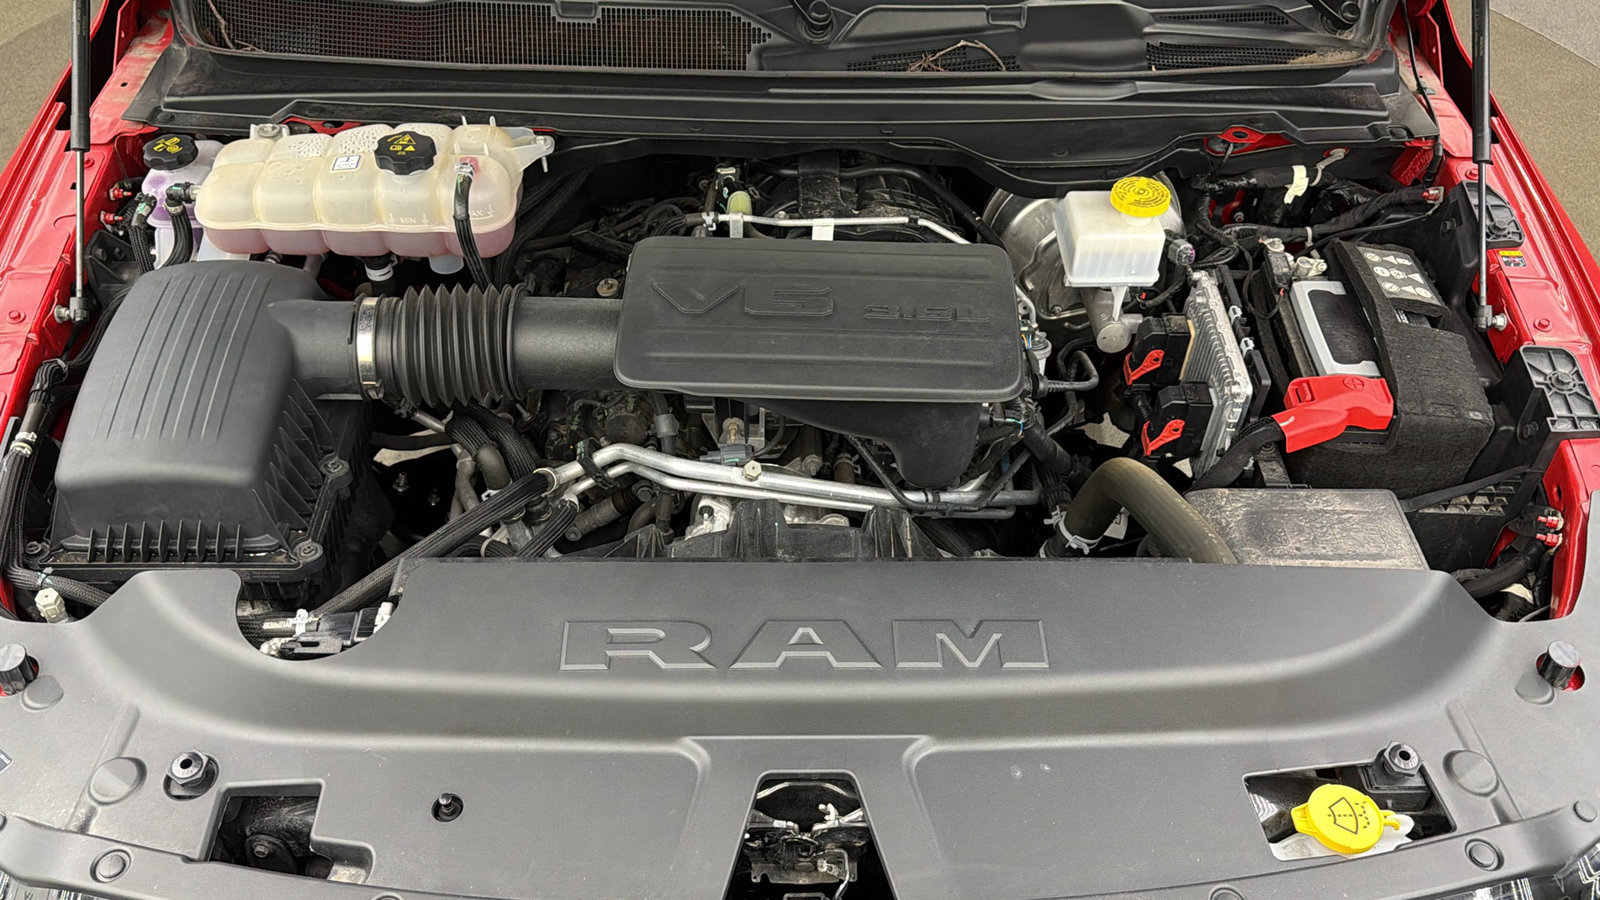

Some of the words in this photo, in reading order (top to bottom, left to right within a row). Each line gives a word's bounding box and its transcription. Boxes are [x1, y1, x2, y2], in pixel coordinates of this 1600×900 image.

[399, 217, 417, 225] MIN
[651, 280, 836, 317] V6
[863, 303, 991, 324] 3.6L
[559, 618, 1052, 672] RAM
